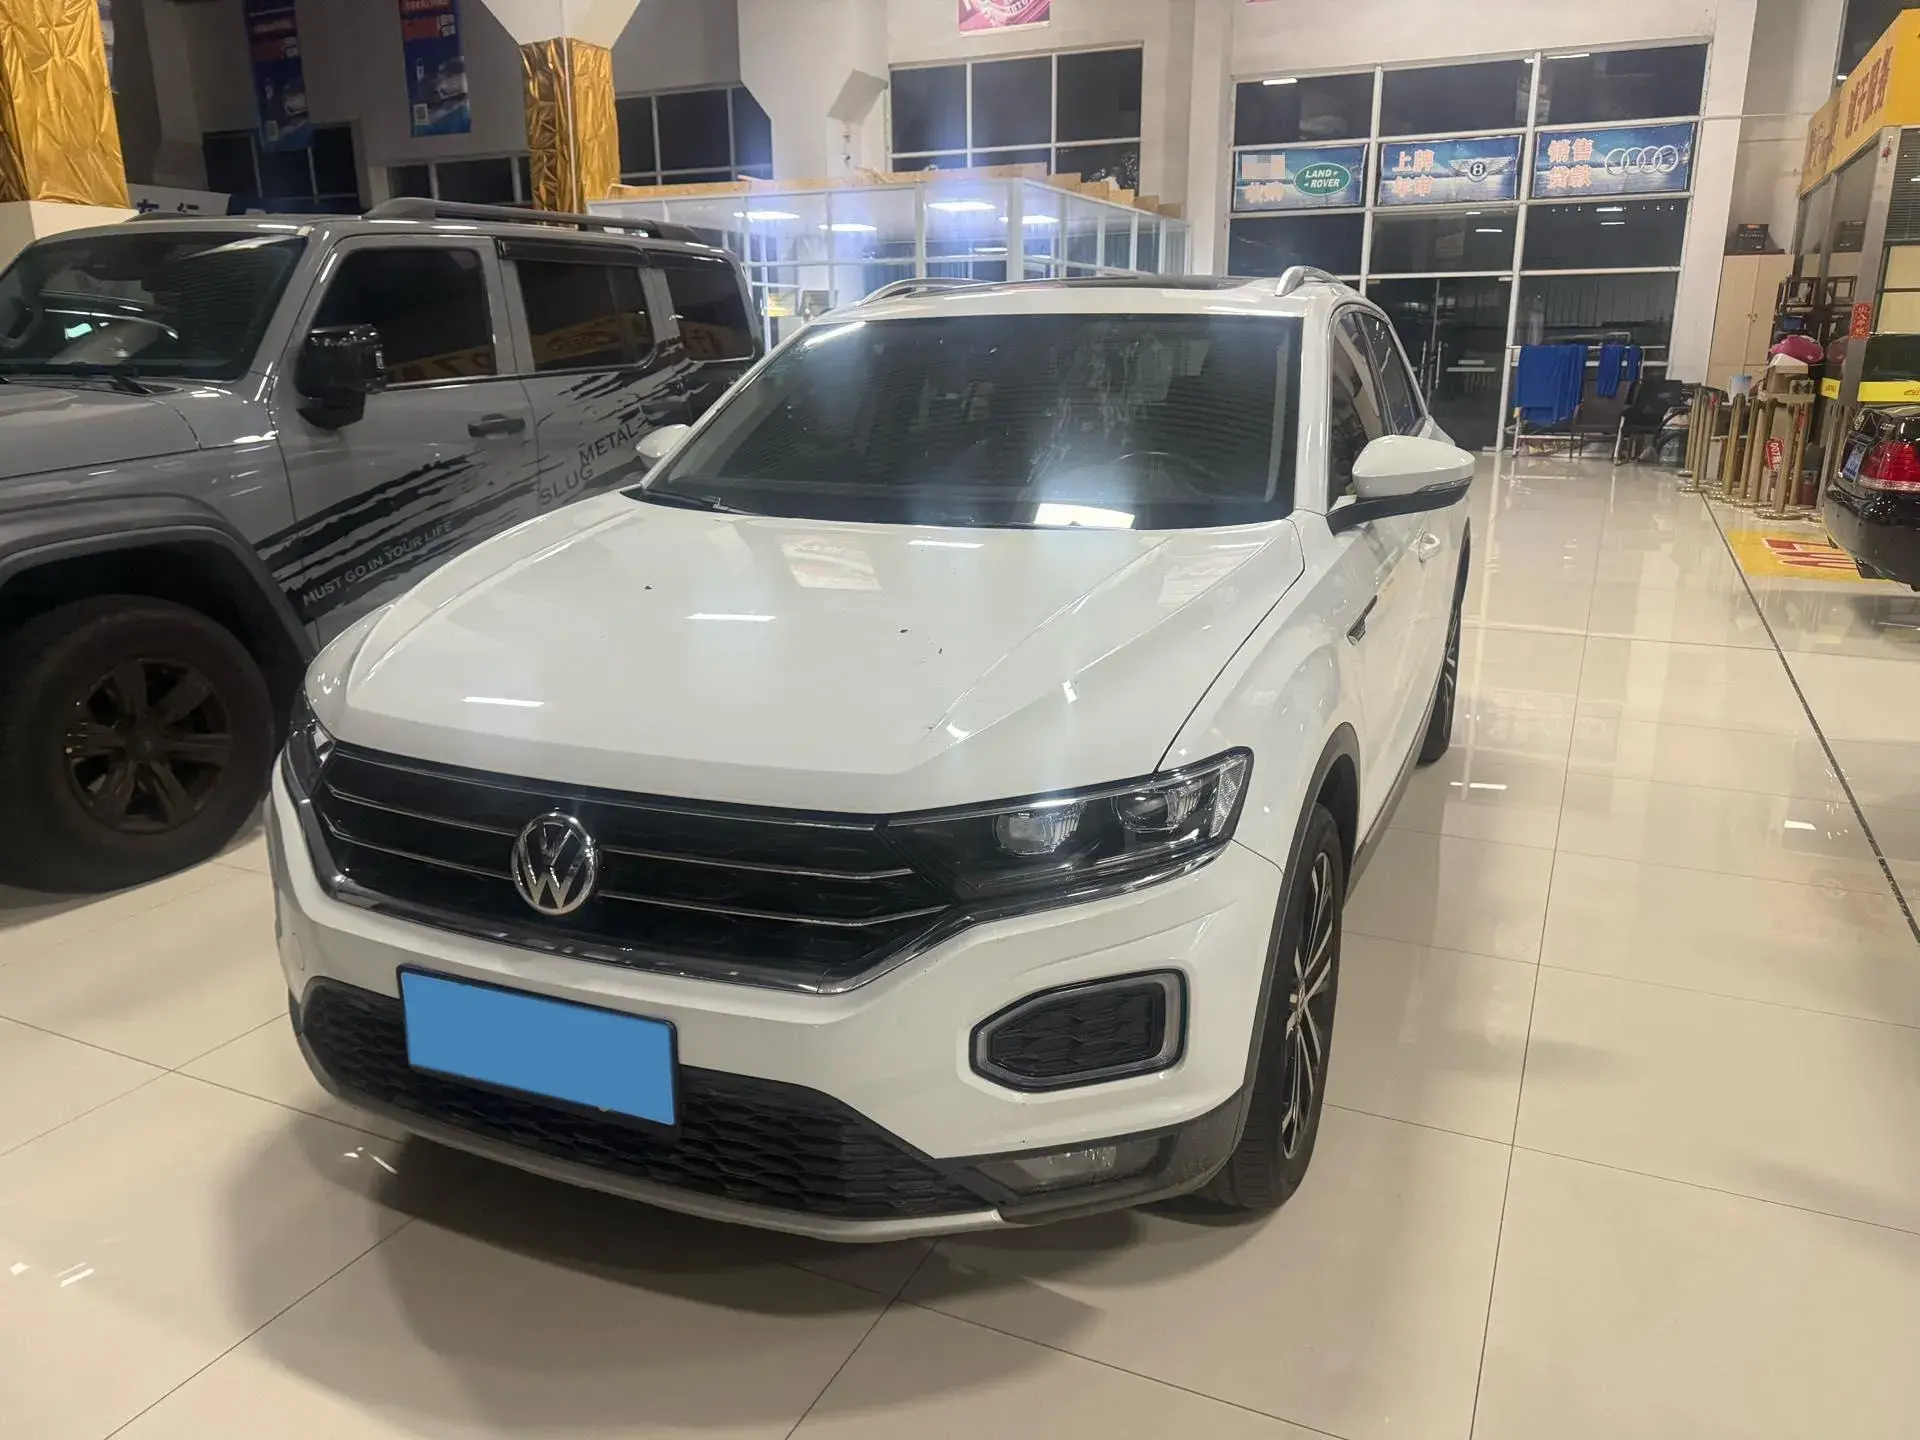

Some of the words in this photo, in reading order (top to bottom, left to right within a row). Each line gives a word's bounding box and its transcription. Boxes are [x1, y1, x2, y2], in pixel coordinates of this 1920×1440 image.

[1548, 138, 1594, 163] 销售
[1305, 169, 1332, 178] LAND
[1310, 179, 1340, 188] ROVER
[579, 423, 639, 467] METAL
[541, 464, 593, 505] SLUG
[303, 577, 341, 606] MUST
[344, 564, 366, 583] GO
[368, 555, 383, 571] IN
[384, 536, 422, 560] YOUR
[424, 520, 452, 542] LIFE
